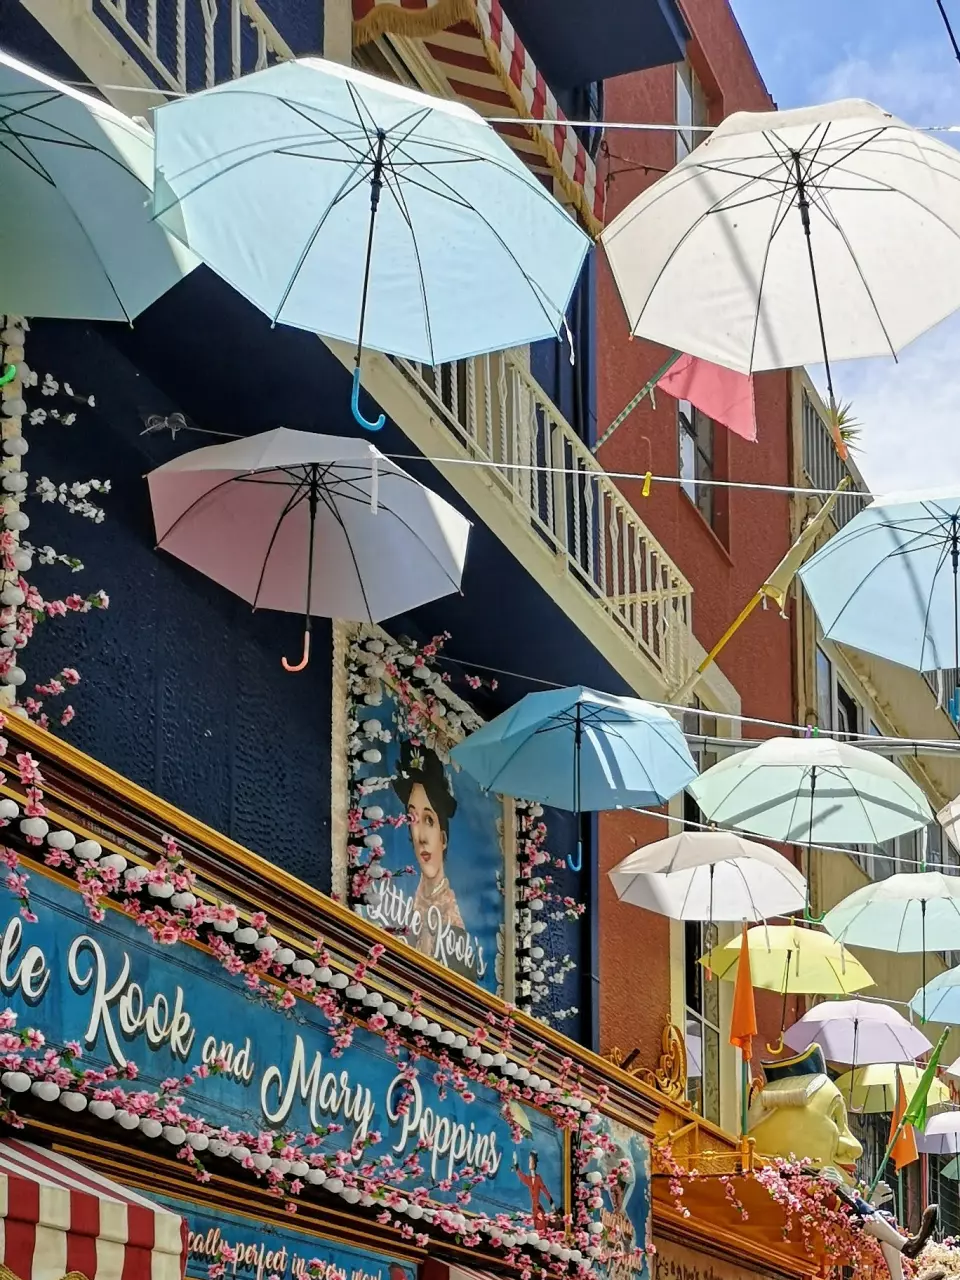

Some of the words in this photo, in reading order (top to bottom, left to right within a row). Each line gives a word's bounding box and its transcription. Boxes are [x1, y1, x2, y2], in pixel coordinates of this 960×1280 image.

[428, 905, 488, 976] Kook's
[68, 935, 195, 1069] Kook
[202, 1036, 255, 1080] and
[261, 1035, 375, 1161] Mary
[387, 1072, 501, 1182] Poppins
